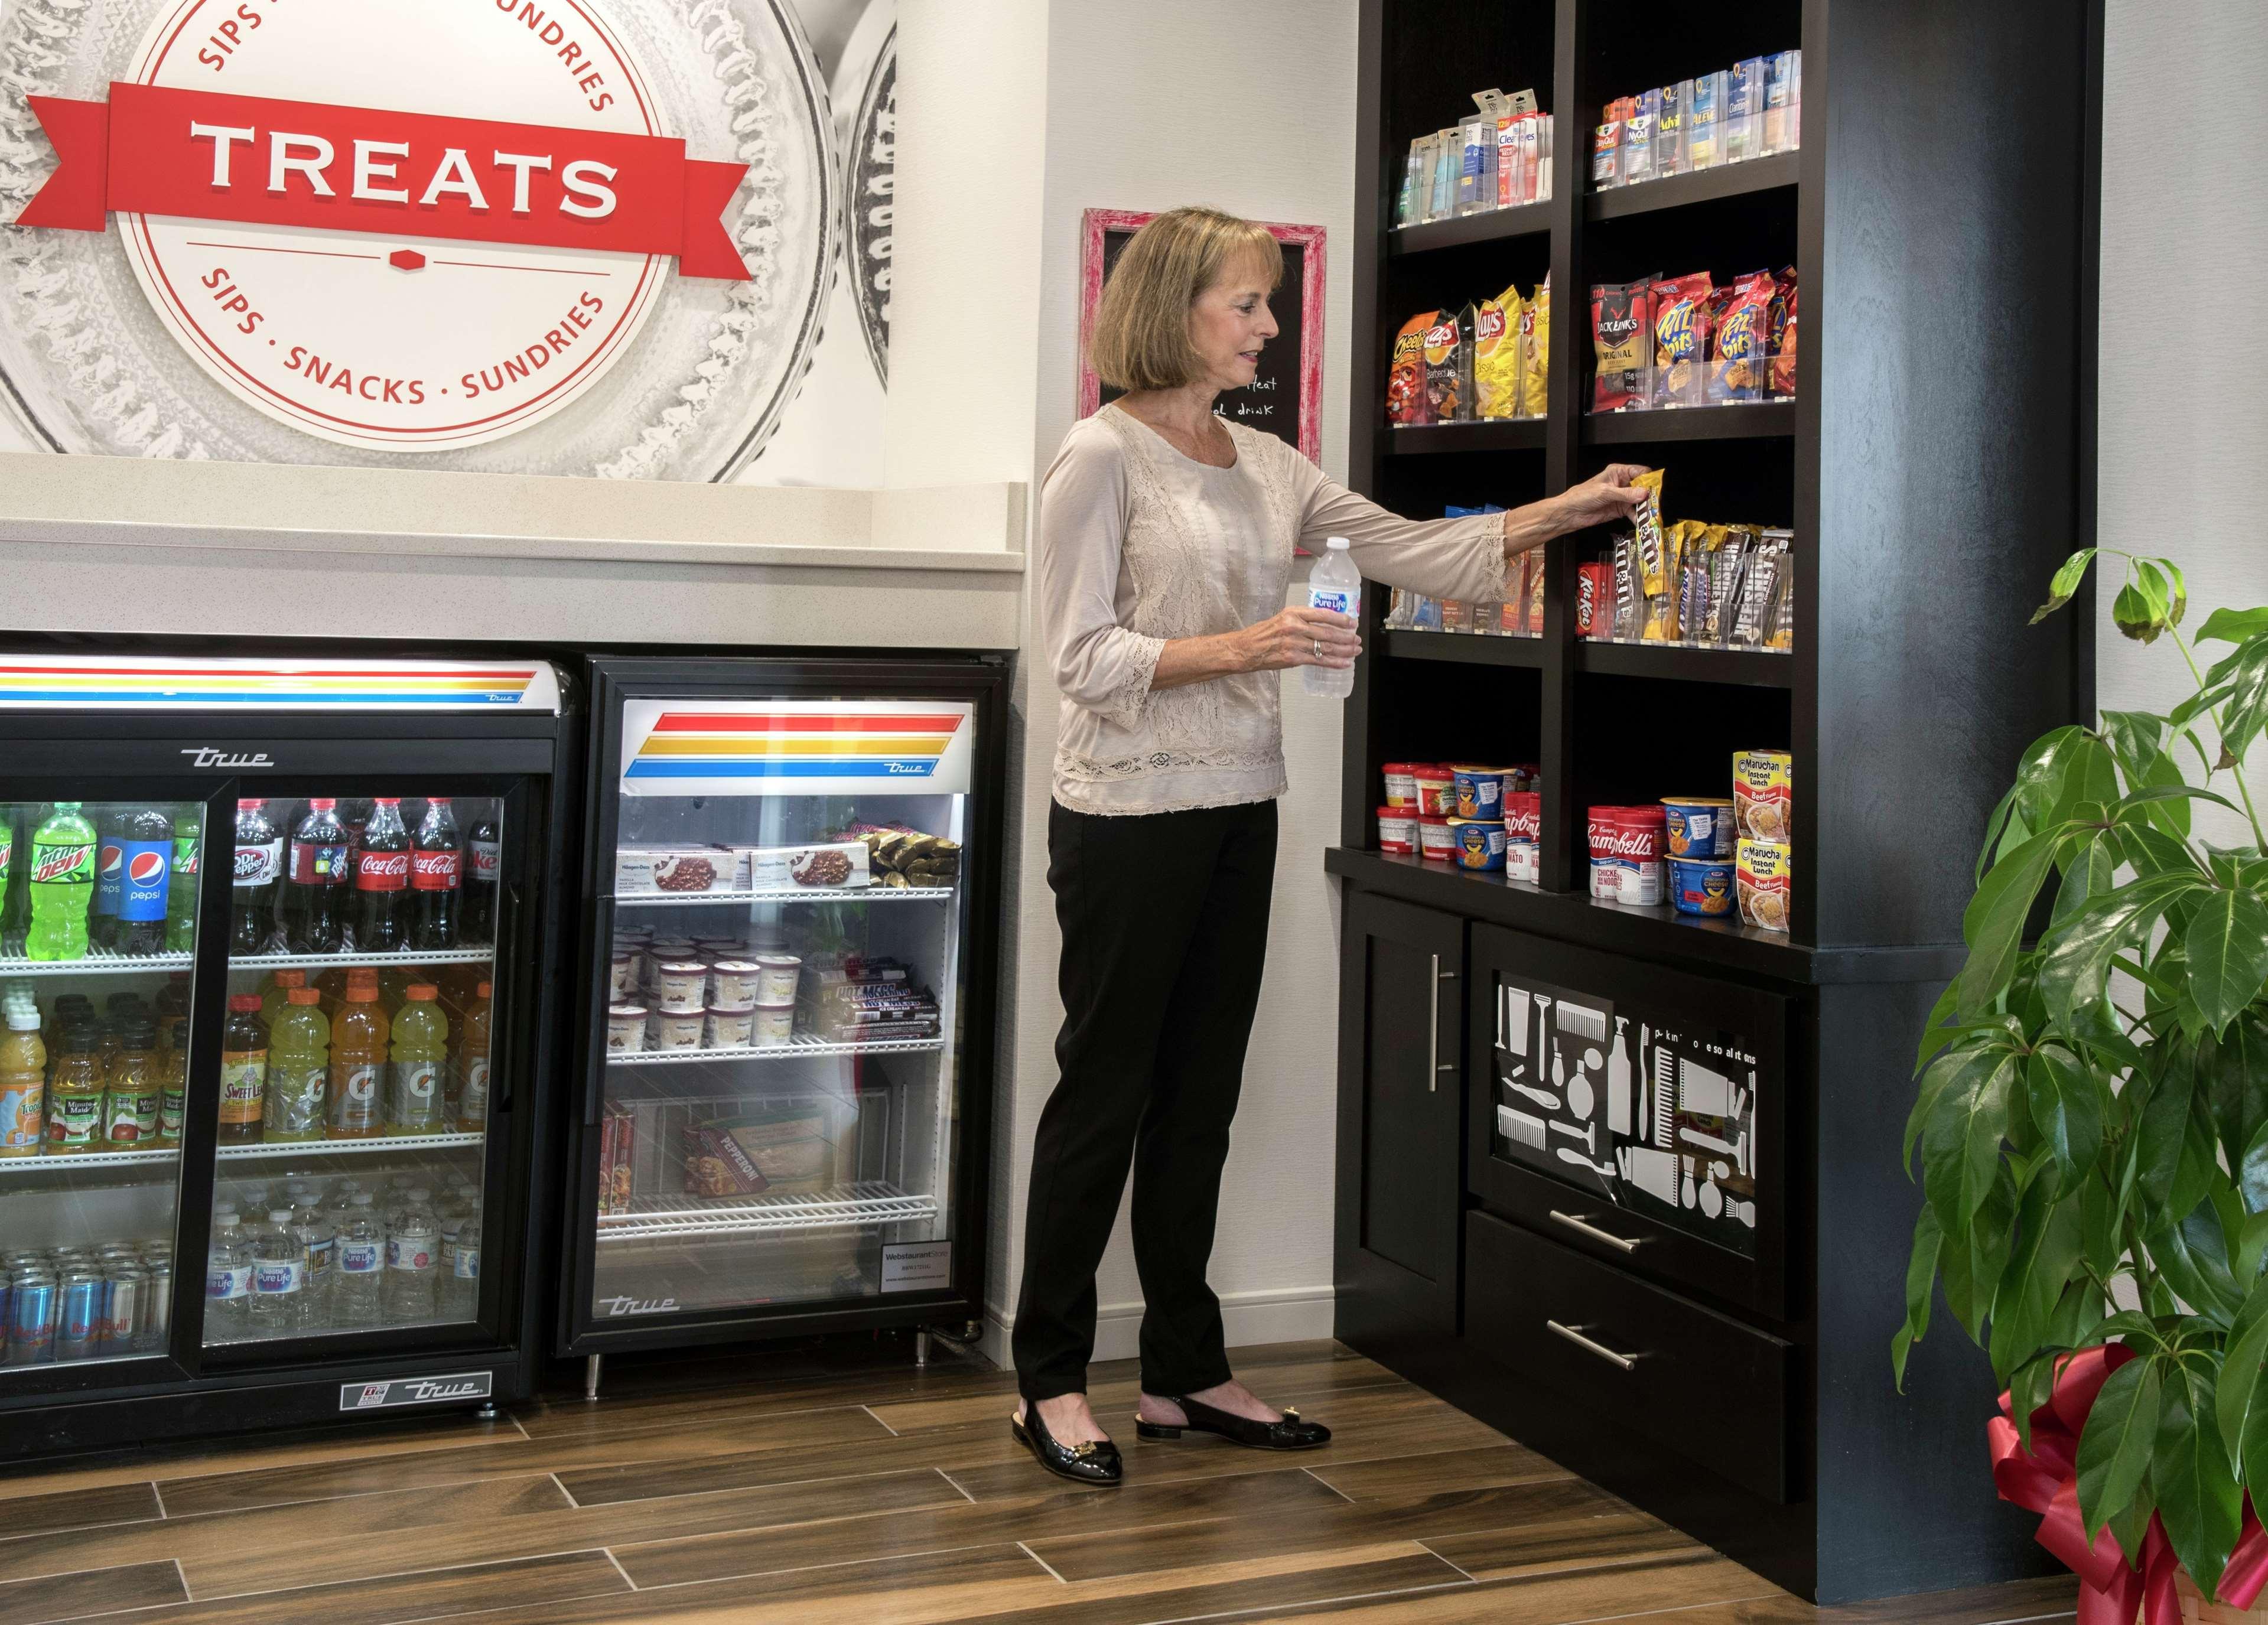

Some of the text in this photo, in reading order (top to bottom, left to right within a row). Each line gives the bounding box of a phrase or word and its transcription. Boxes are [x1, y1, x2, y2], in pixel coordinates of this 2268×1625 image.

[198, 4, 262, 71] SIPS
[1659, 114, 1680, 131] Advil
[190, 120, 619, 219] TREATS
[201, 267, 604, 405] SIPS SNACKS SUNDRIES
[1394, 328, 1426, 362] Cheeto
[1314, 598, 1346, 611] Pure Life
[181, 747, 275, 767] true
[884, 762, 926, 773] true
[1747, 758, 1779, 771] Maruchan
[1748, 770, 1771, 780] Instant
[1750, 777, 1768, 786] Lunch
[1752, 792, 1766, 802] Beef
[480, 847, 498, 856] Diet
[242, 854, 256, 863] Dr
[413, 854, 458, 874] oca-Cola
[473, 851, 497, 870] ke
[1752, 858, 1775, 868] Instant
[1597, 869, 1617, 877] CHICKE
[1753, 865, 1773, 875] Lunch
[100, 884, 121, 894] peps
[1755, 880, 1770, 890] Beef
[131, 890, 160, 901] pepsi
[349, 1070, 375, 1100] G
[409, 1067, 435, 1098] G
[721, 1136, 759, 1181] PEPPERONI
[362, 1254, 375, 1263] Life
[217, 1279, 232, 1290] Life
[277, 1275, 291, 1285] Life
[598, 1295, 680, 1315] true
[405, 1381, 480, 1399] true
